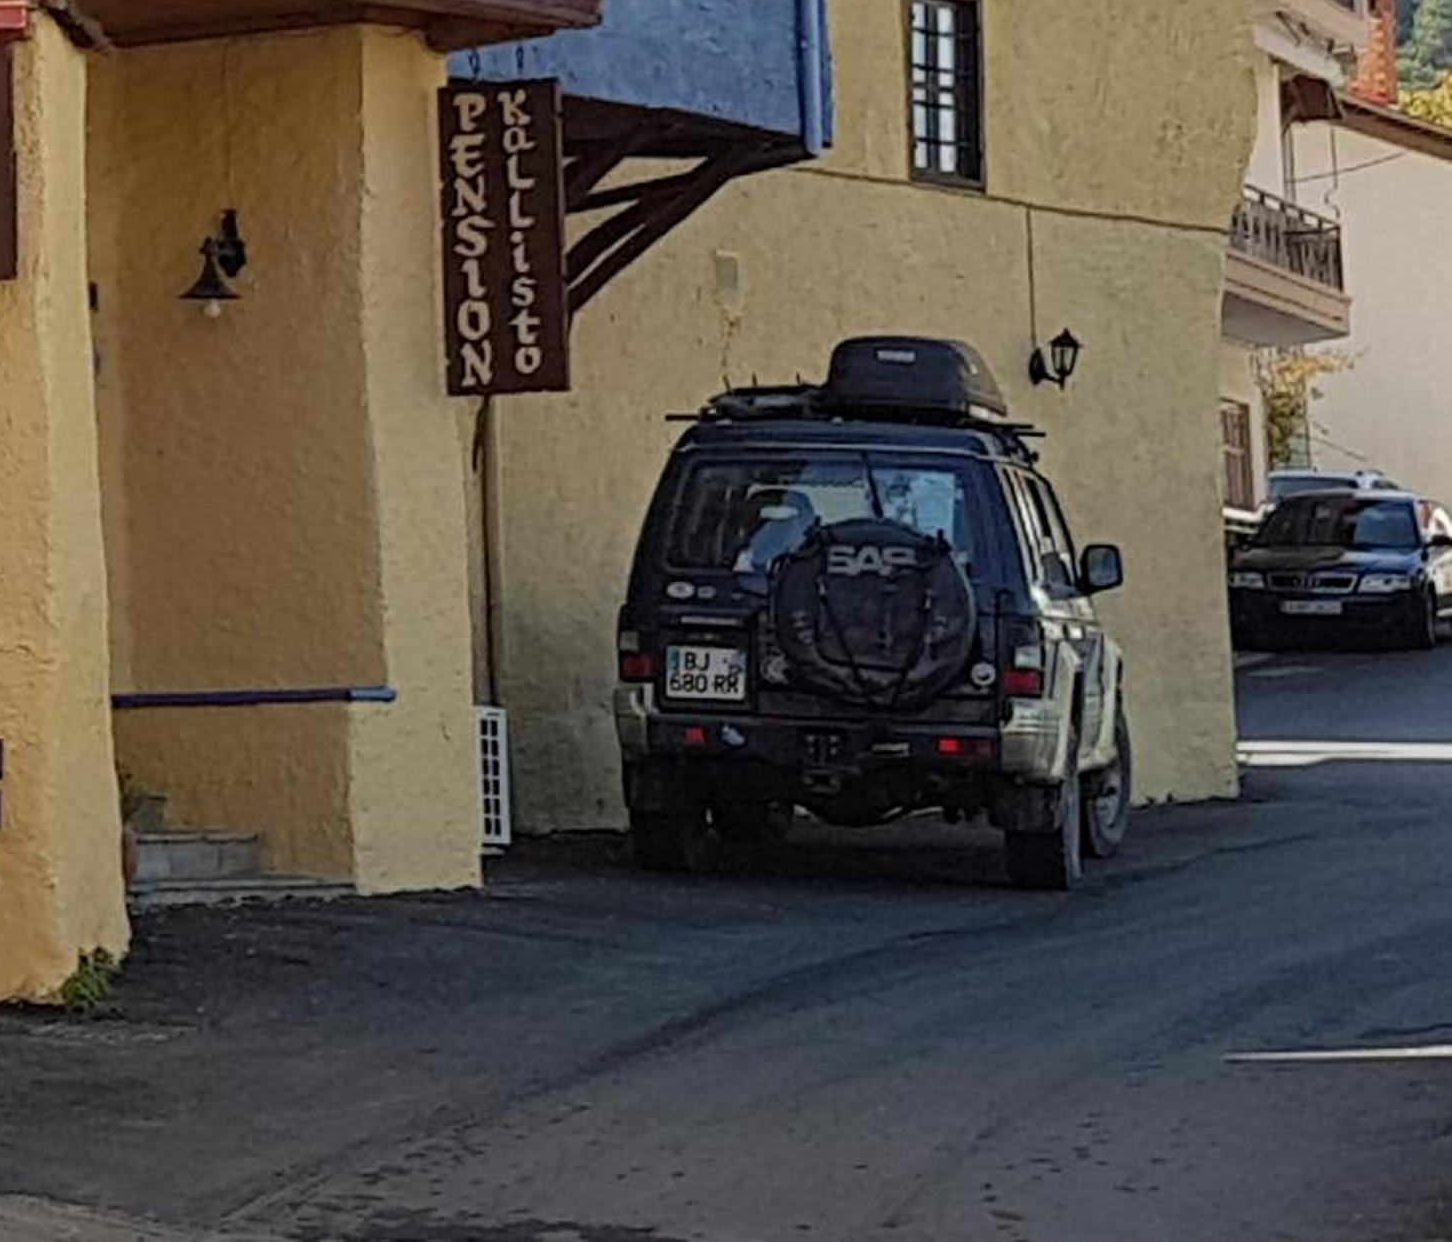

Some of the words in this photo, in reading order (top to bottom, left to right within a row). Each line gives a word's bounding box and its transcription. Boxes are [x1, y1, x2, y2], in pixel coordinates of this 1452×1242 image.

[450, 92, 496, 388] PENSION
[684, 651, 710, 672] BJ
[669, 672, 708, 694] 680
